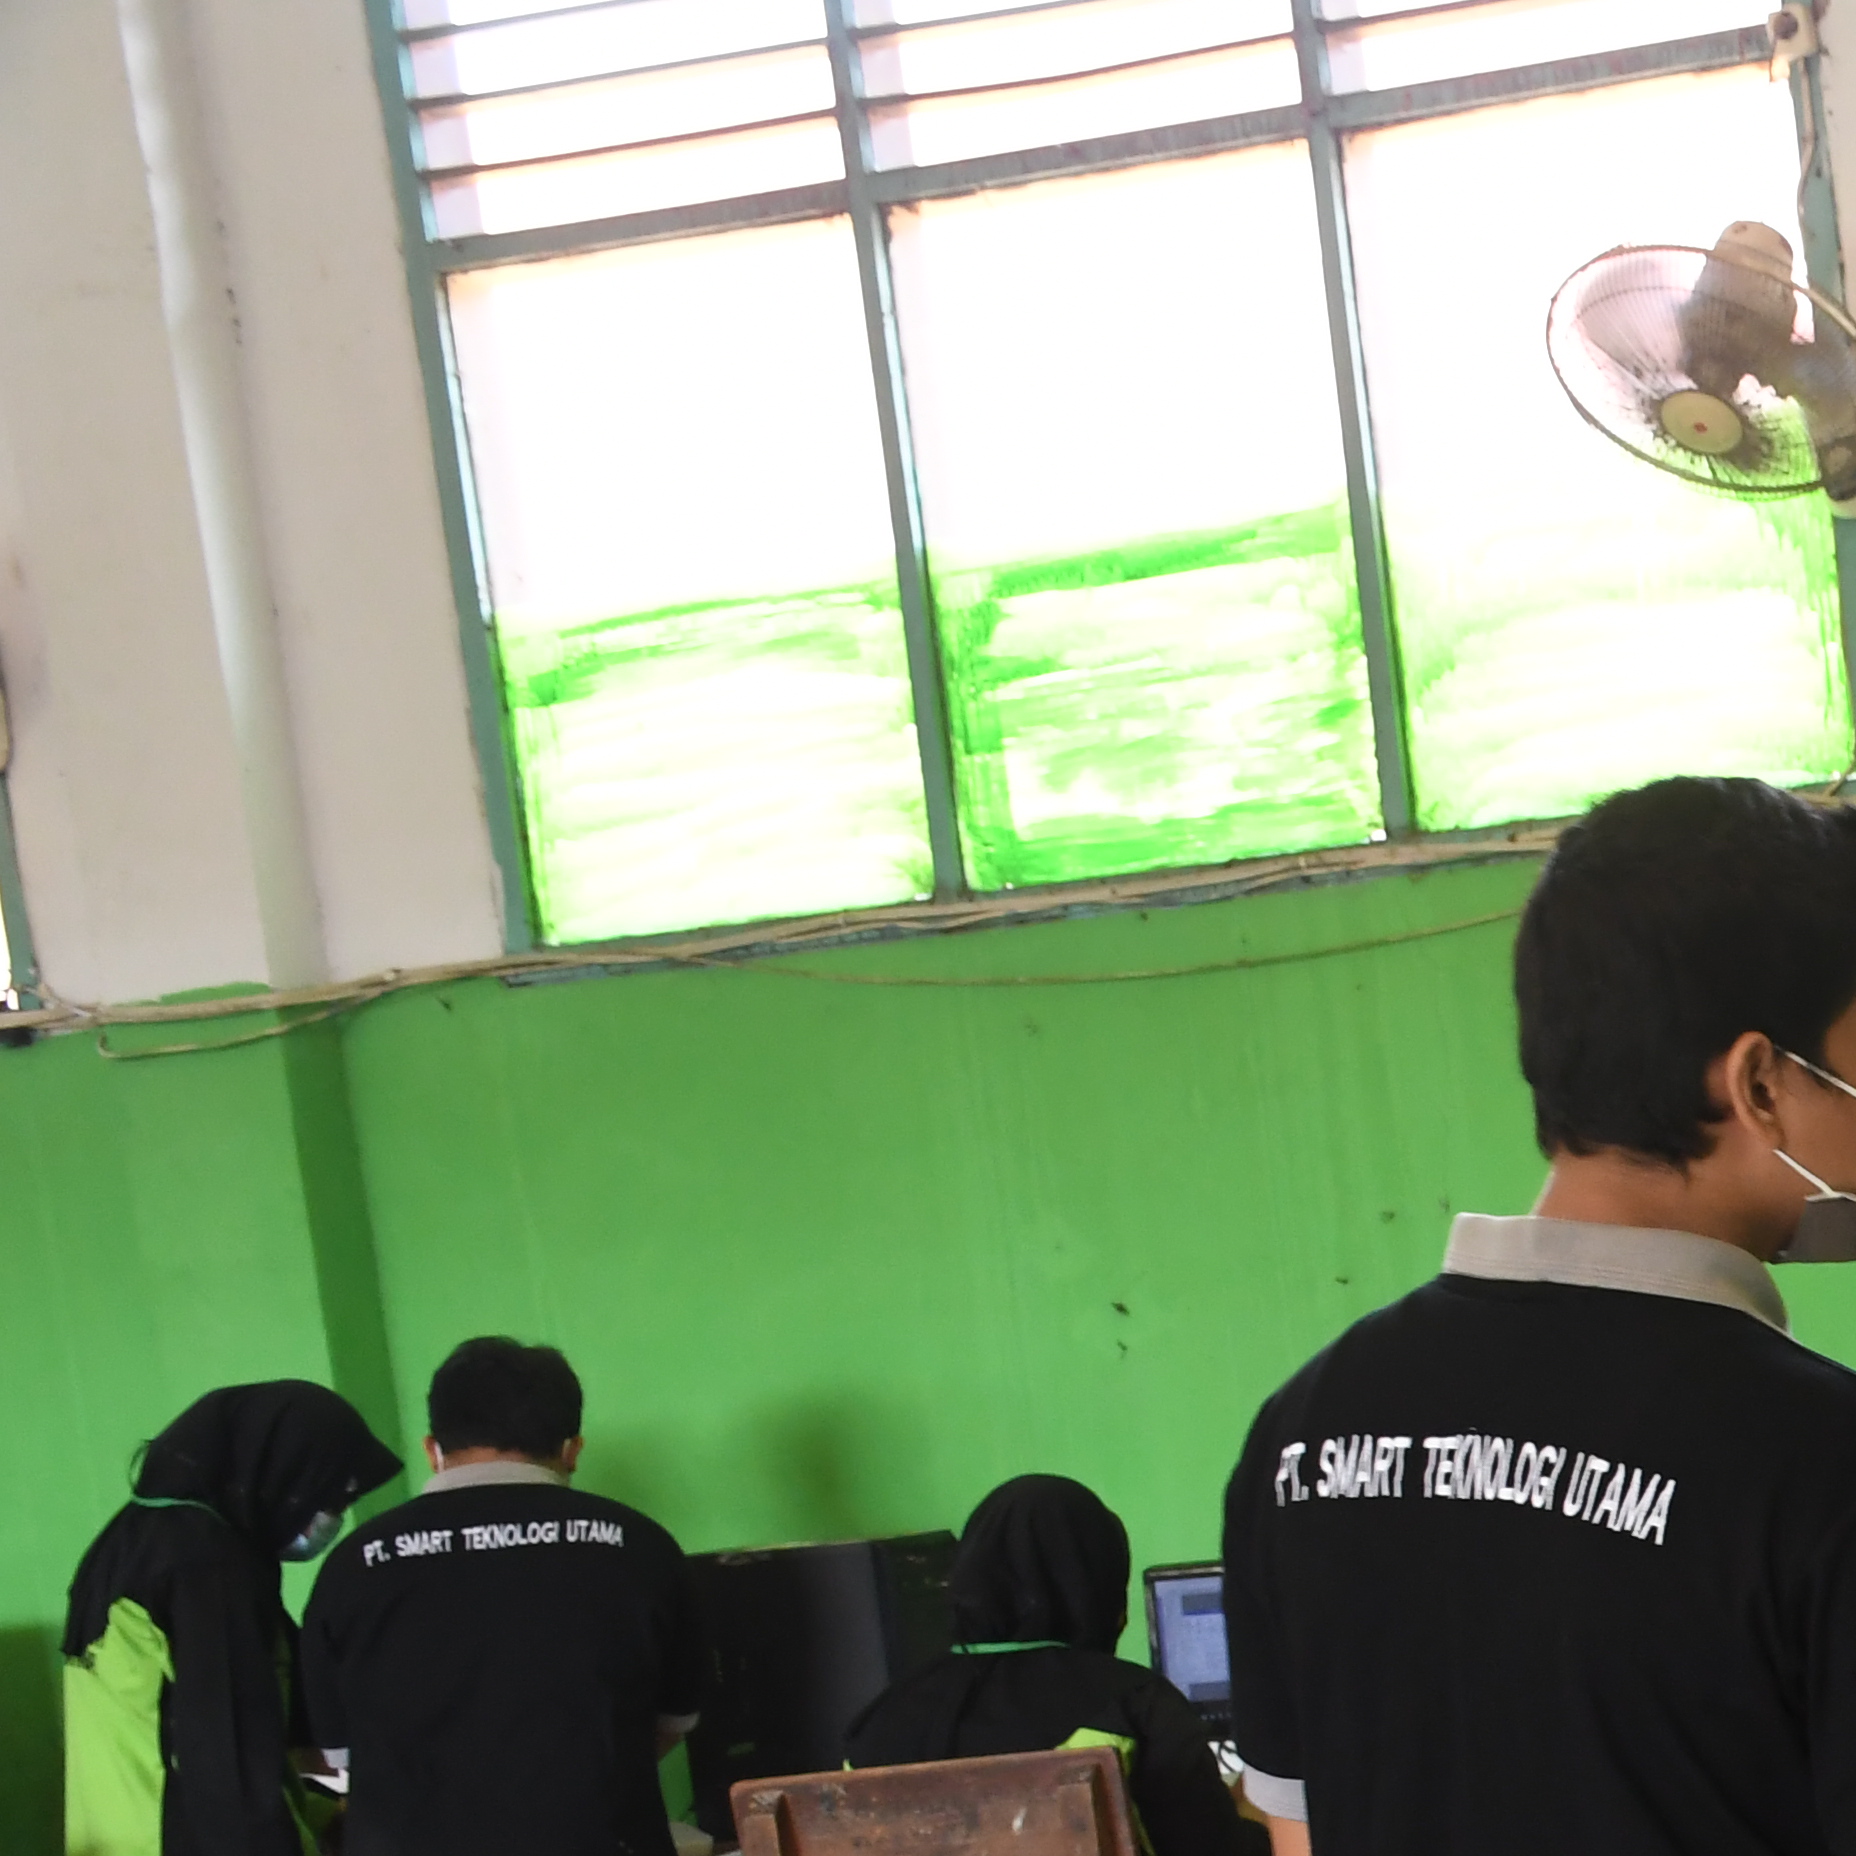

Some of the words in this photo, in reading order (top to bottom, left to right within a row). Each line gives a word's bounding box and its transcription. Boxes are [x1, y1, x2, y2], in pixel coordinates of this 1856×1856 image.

[1315, 1433, 1413, 1499] SMART
[1422, 1433, 1567, 1511] TEKNOLOGI
[1563, 1451, 1677, 1546] UTAMA
[363, 1539, 391, 1567] PT.
[394, 1529, 454, 1557] SMART
[460, 1521, 560, 1551] TEKNOLOGI
[565, 1519, 625, 1548] UTAMA
